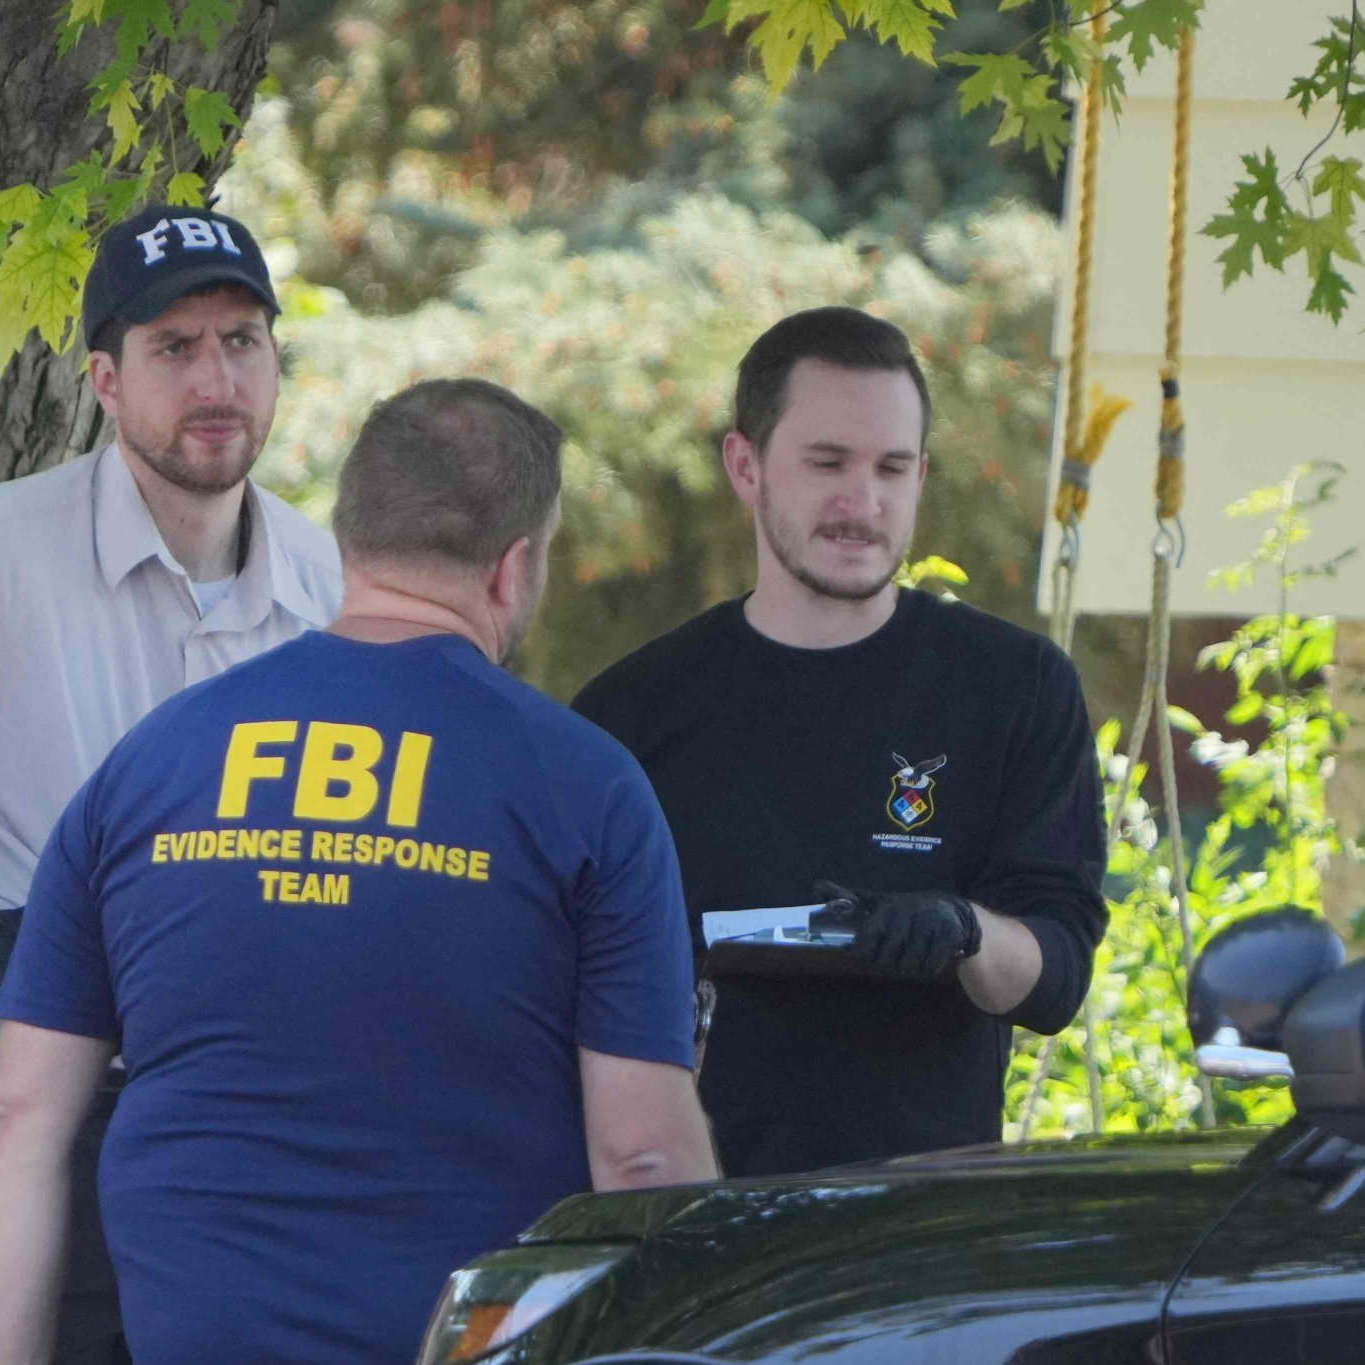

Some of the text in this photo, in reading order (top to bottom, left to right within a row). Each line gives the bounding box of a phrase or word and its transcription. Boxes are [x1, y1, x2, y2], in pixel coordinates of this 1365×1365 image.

[135, 217, 242, 267] FBI
[217, 720, 433, 828] FBI
[915, 801, 923, 811] 4
[151, 829, 492, 881] EVIDENCE RESPONSE
[872, 833, 942, 844] HAZARDOUS EVIDENCE
[880, 841, 933, 850] RESPONSE TEAM
[257, 870, 351, 905] TEAM
